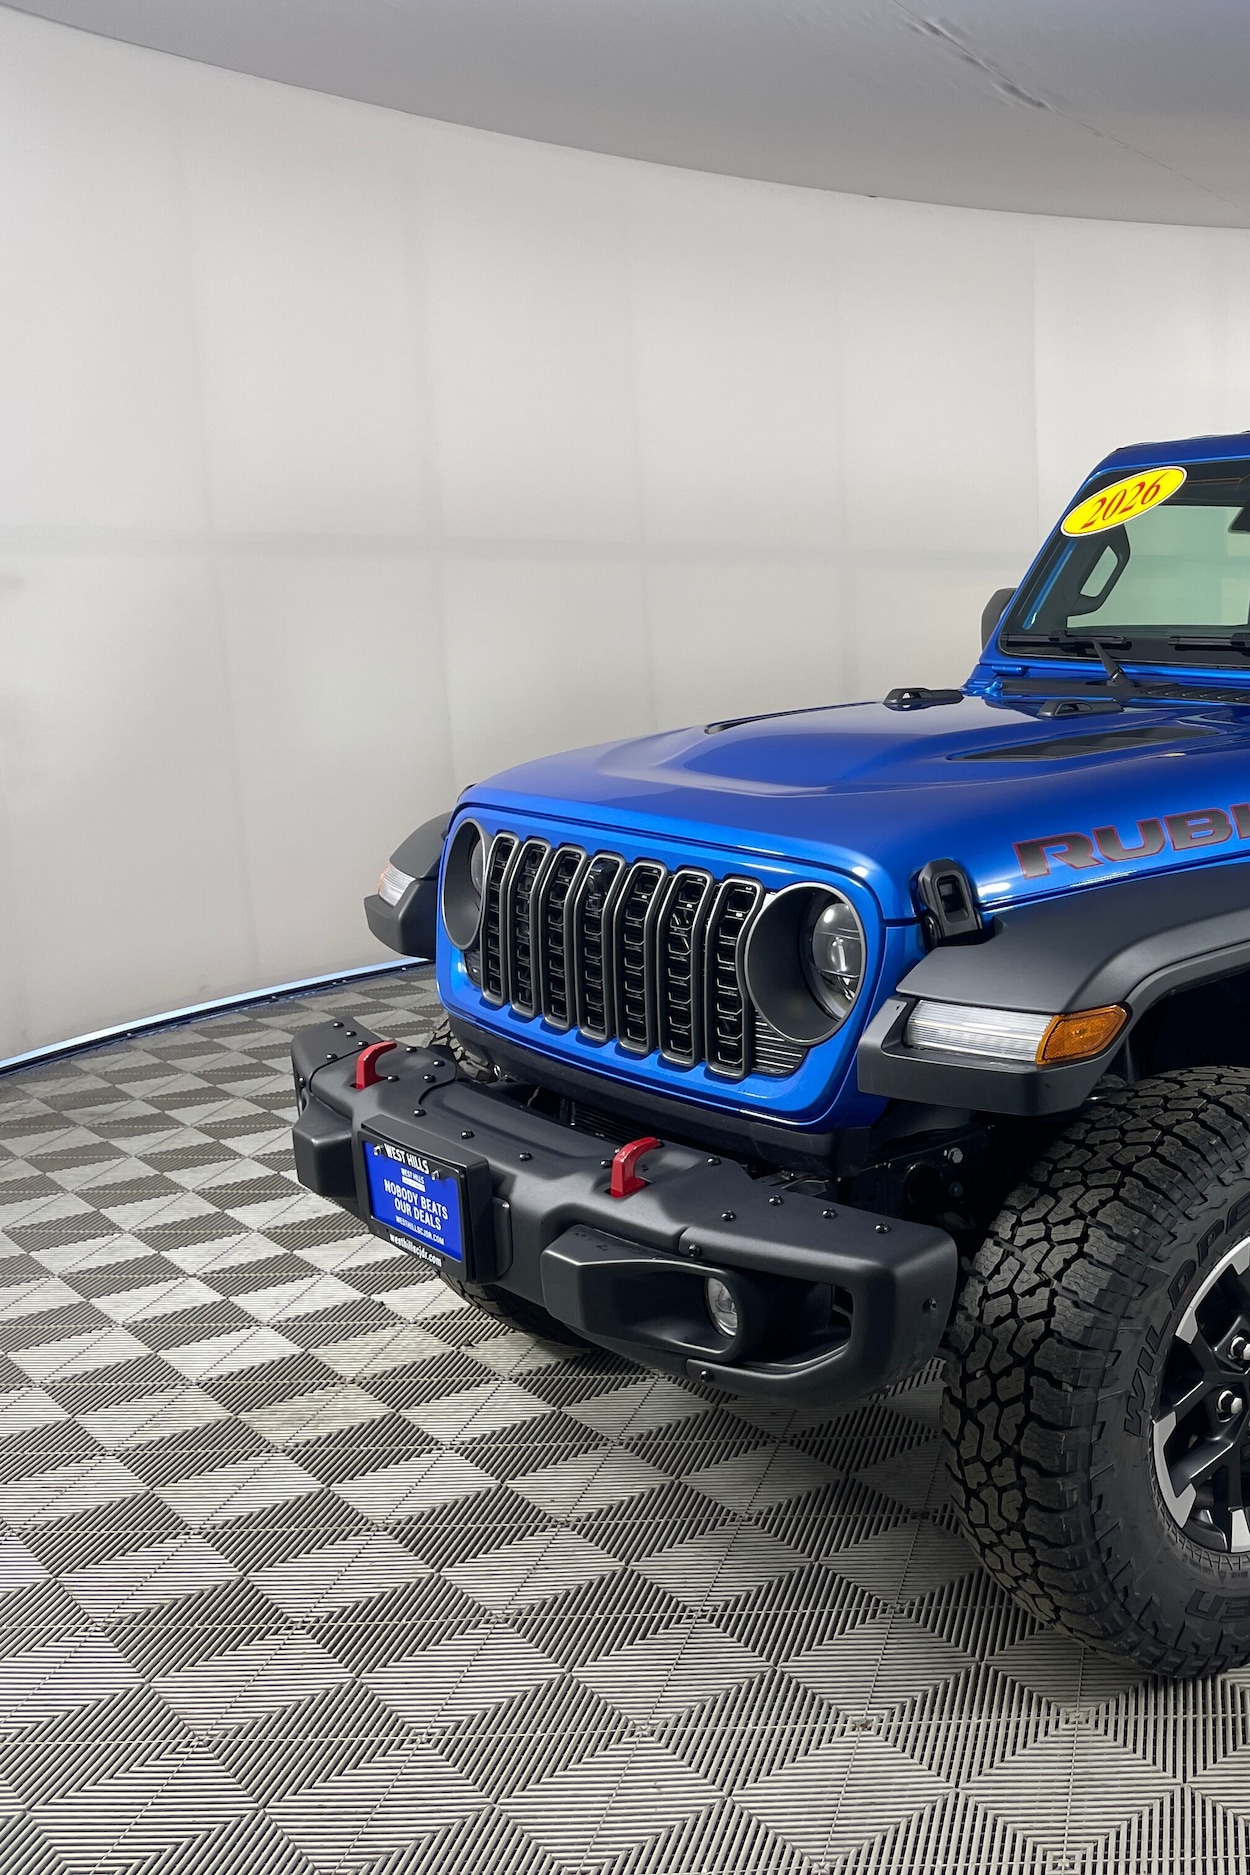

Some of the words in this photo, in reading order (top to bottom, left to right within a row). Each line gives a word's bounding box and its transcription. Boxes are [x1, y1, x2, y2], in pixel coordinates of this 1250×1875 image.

[1080, 471, 1170, 530] 2026
[384, 1143, 406, 1164] WEST
[406, 1153, 430, 1175] HILLS
[401, 1167, 413, 1179] WEST
[383, 1179, 418, 1206] NOBODY
[420, 1195, 449, 1220] BEATS
[394, 1197, 413, 1217] OUR
[413, 1206, 442, 1231] DEALS
